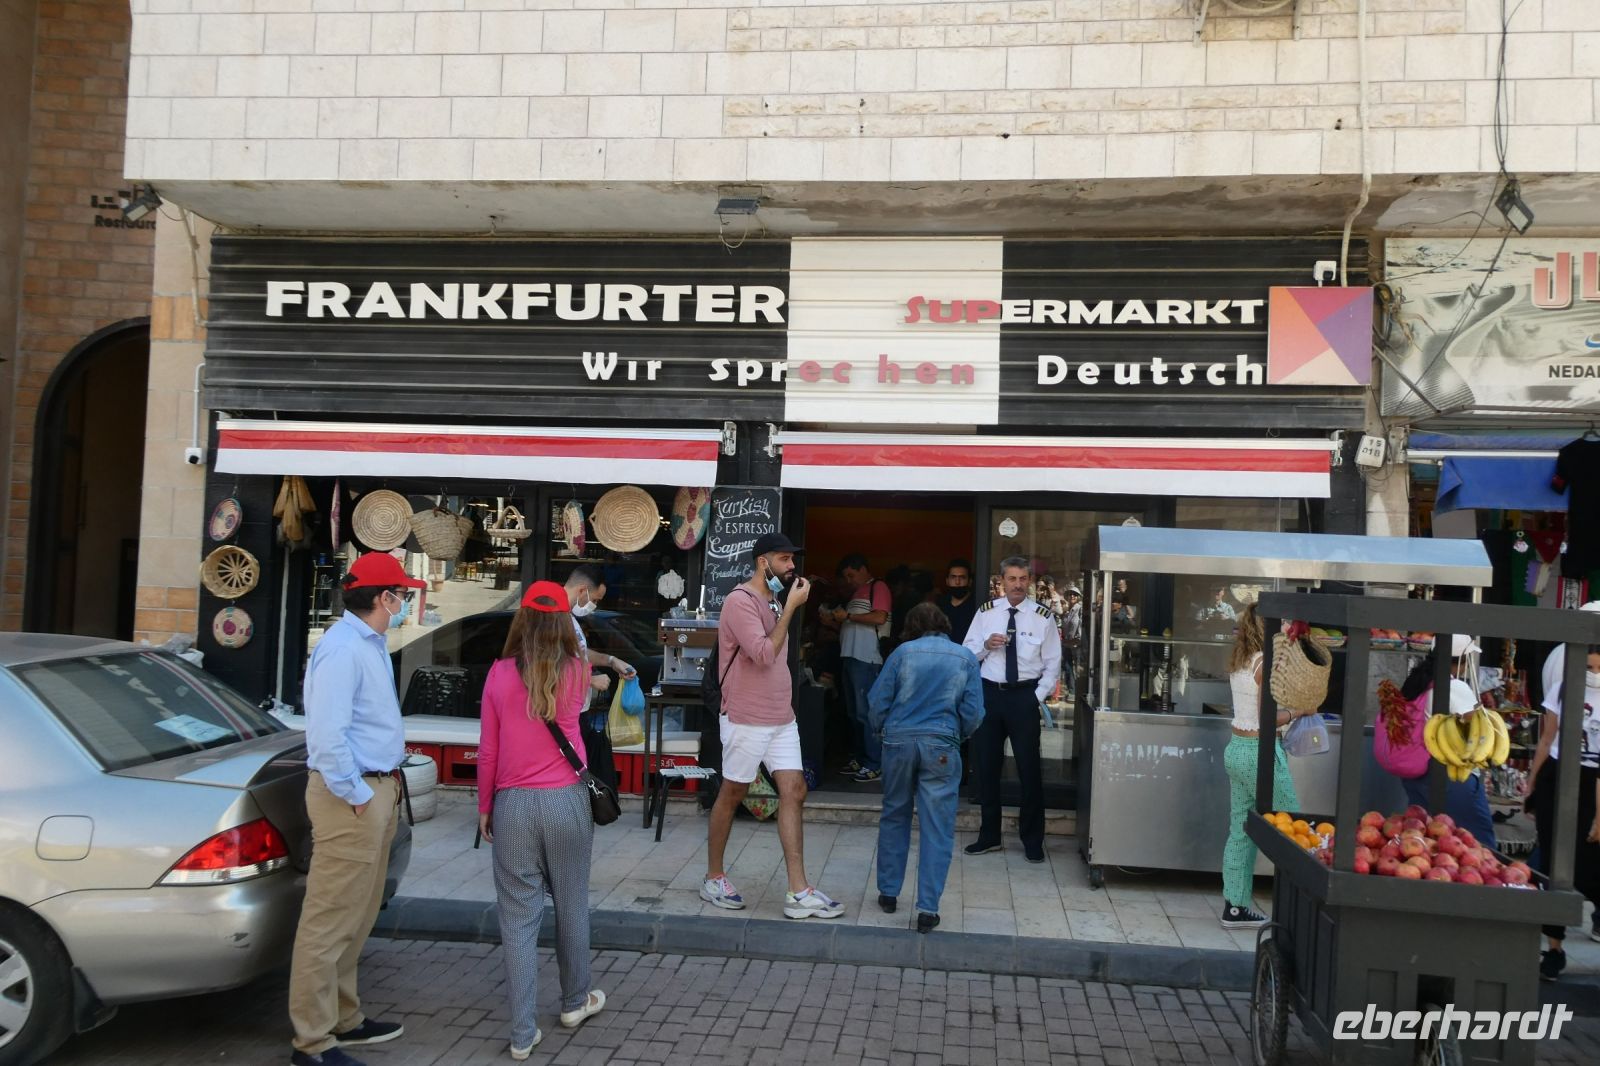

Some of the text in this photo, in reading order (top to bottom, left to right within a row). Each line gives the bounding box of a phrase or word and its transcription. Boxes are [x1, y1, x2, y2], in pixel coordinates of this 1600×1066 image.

[265, 280, 1264, 324] FRANKFURTER SUPERMARKT
[582, 352, 662, 381] Wir
[1037, 354, 1263, 385] Deutsch
